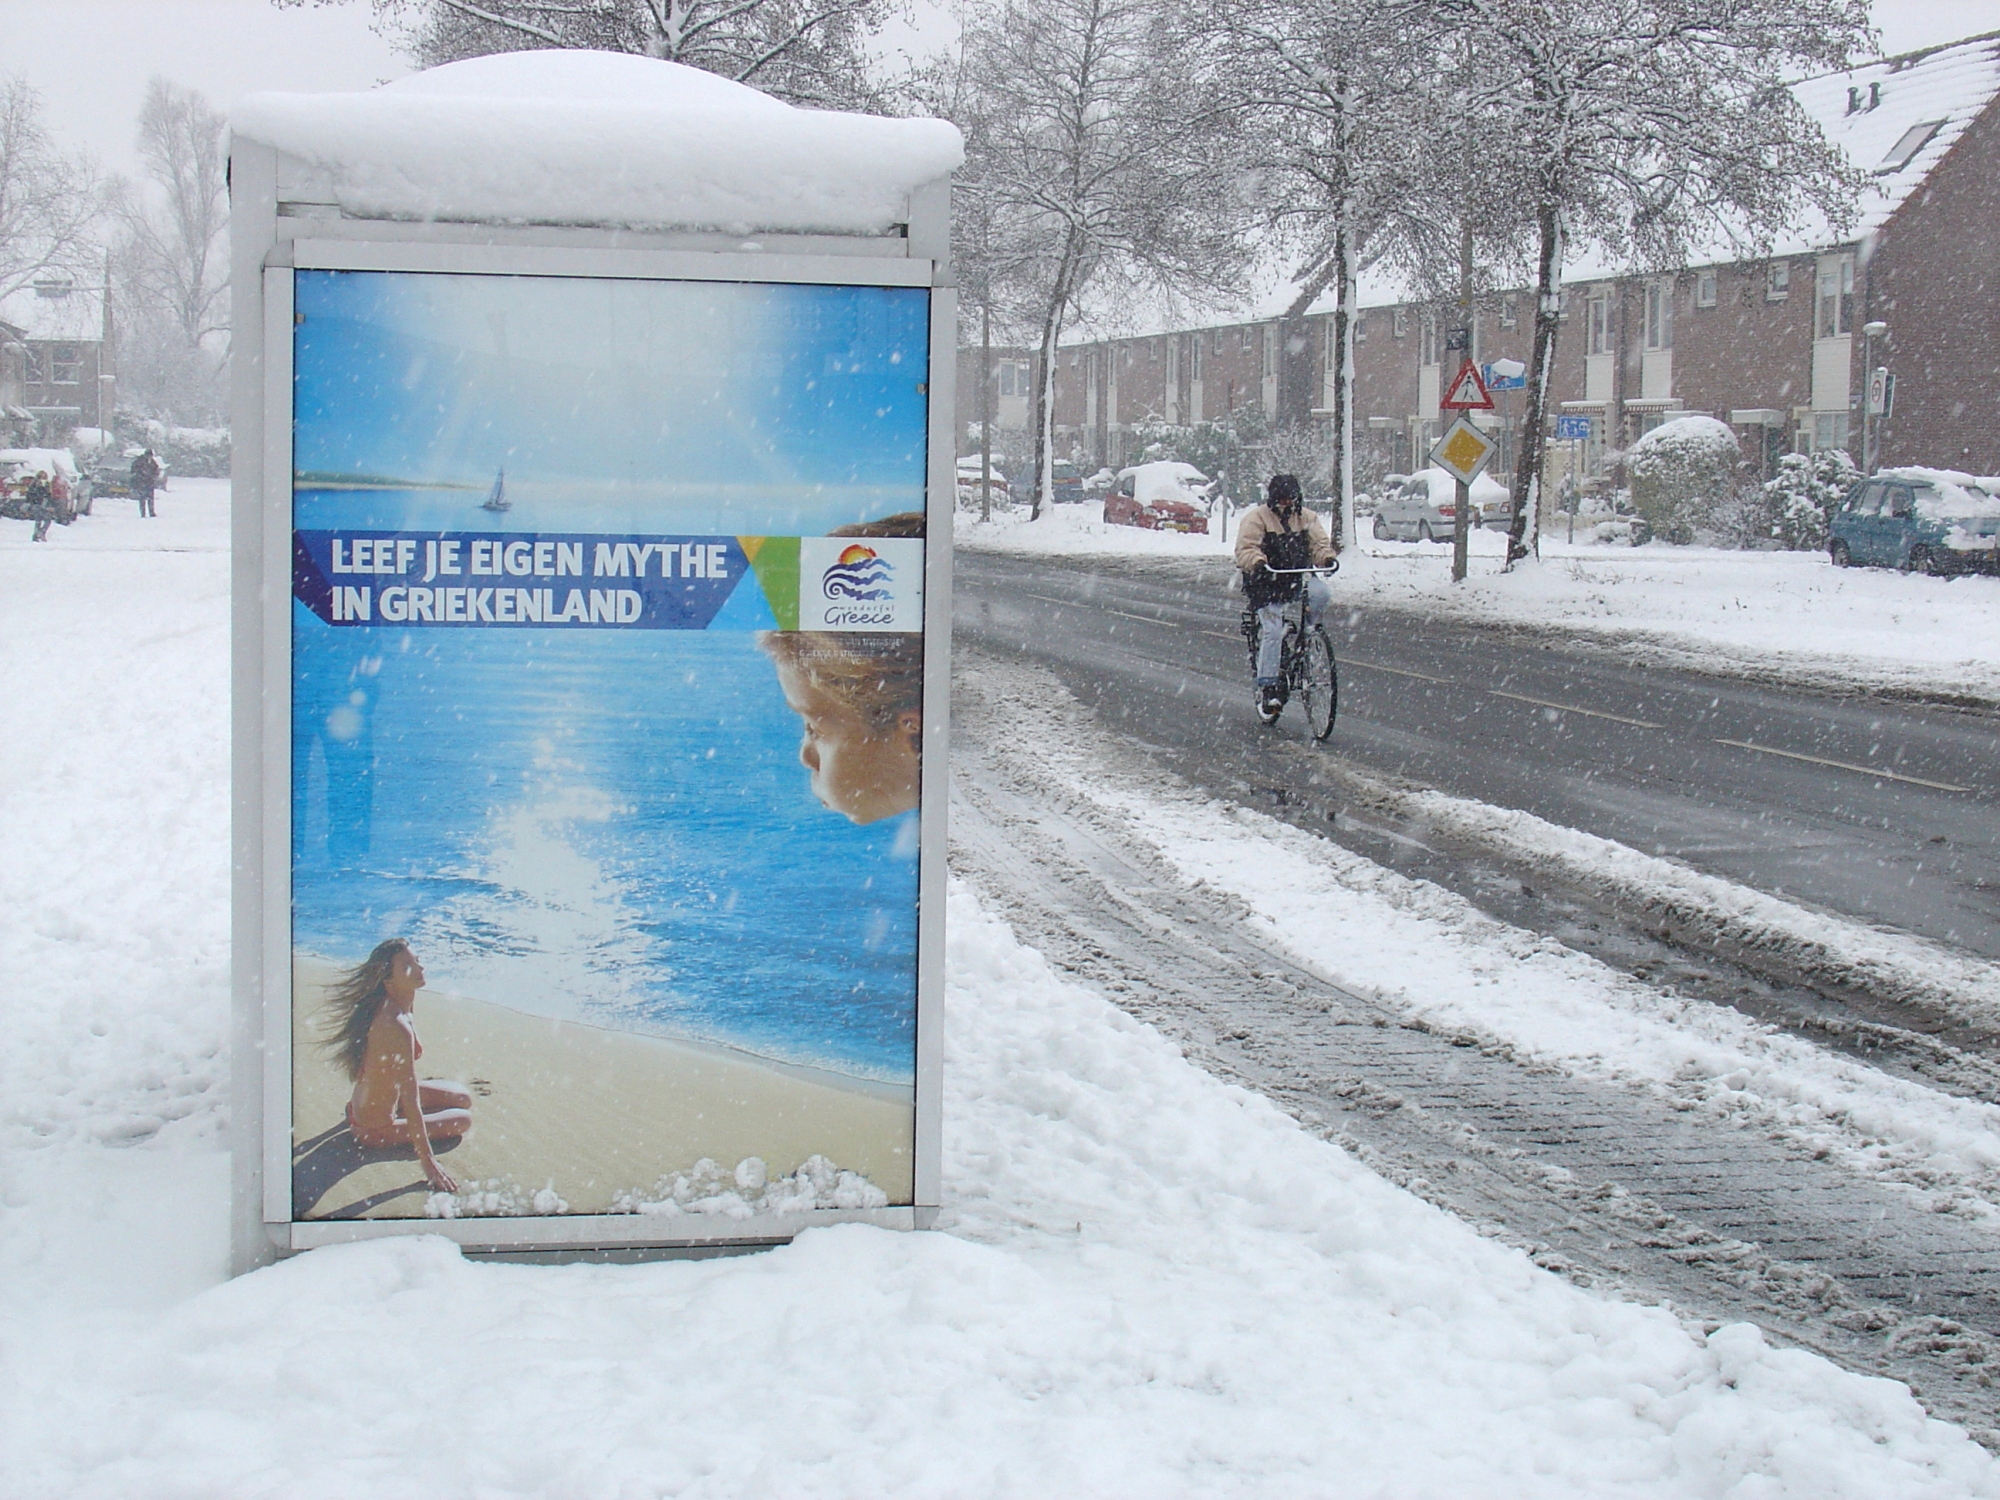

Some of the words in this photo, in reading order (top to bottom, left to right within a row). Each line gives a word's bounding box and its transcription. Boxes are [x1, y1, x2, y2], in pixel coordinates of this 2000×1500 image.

[331, 538, 417, 575] LEEF
[421, 539, 462, 583] JE
[471, 540, 583, 577] EIGEN
[593, 542, 728, 579] MYTHE
[331, 586, 371, 621] IN
[378, 586, 643, 624] GRIEKENLAND
[823, 606, 895, 626] Greece
